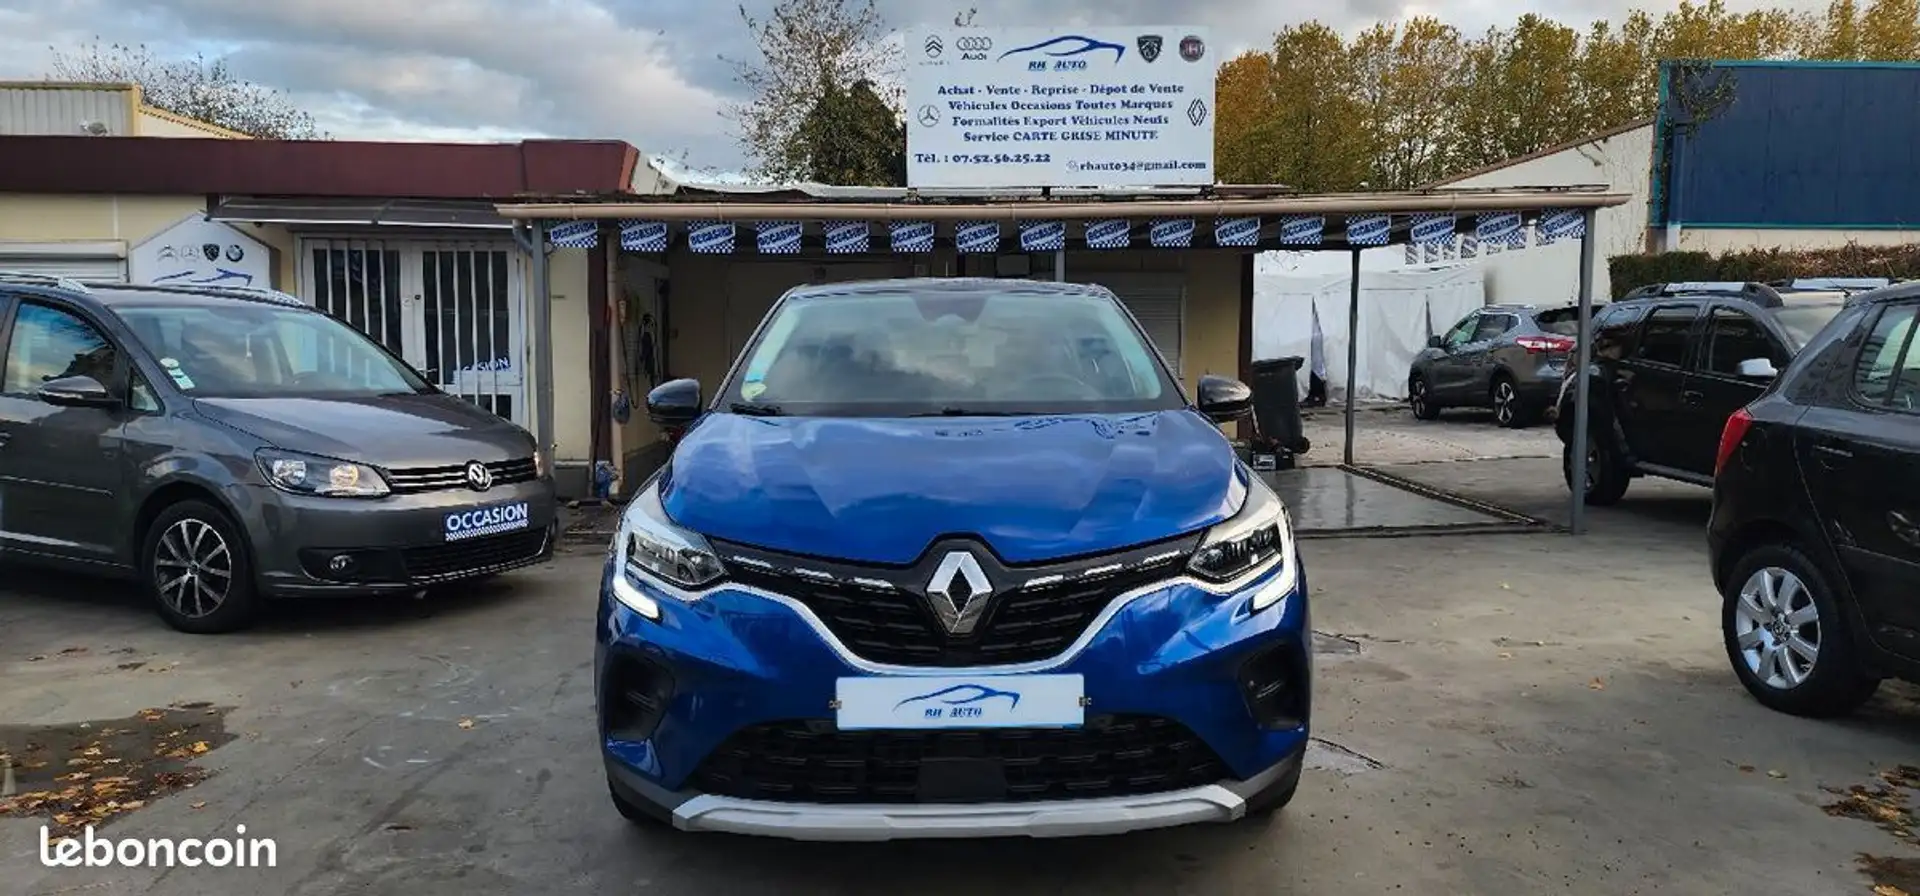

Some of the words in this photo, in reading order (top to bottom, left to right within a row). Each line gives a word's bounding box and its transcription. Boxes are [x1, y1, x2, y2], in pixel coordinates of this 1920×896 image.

[1028, 60, 1047, 71] RH
[1053, 60, 1087, 70] AUTO
[937, 85, 975, 95] Achat
[986, 85, 1021, 95] Vente
[1031, 84, 1078, 96] Reprise
[1130, 84, 1145, 94] de
[1149, 83, 1184, 94] Vente
[1011, 101, 1071, 110] Occasions
[1075, 100, 1117, 110] Toutes
[1120, 99, 1173, 111] Marques
[952, 116, 1020, 126] Formalités
[1023, 116, 1067, 128] Export
[1133, 115, 1169, 125] Neufs
[963, 131, 1010, 142] Service
[1013, 131, 1058, 141] CARTE
[1061, 131, 1101, 141] GRISE
[1105, 130, 1158, 140] MINUTE
[446, 503, 529, 531] OCCASION
[924, 708, 942, 718] RH
[950, 707, 982, 718] AUTO
